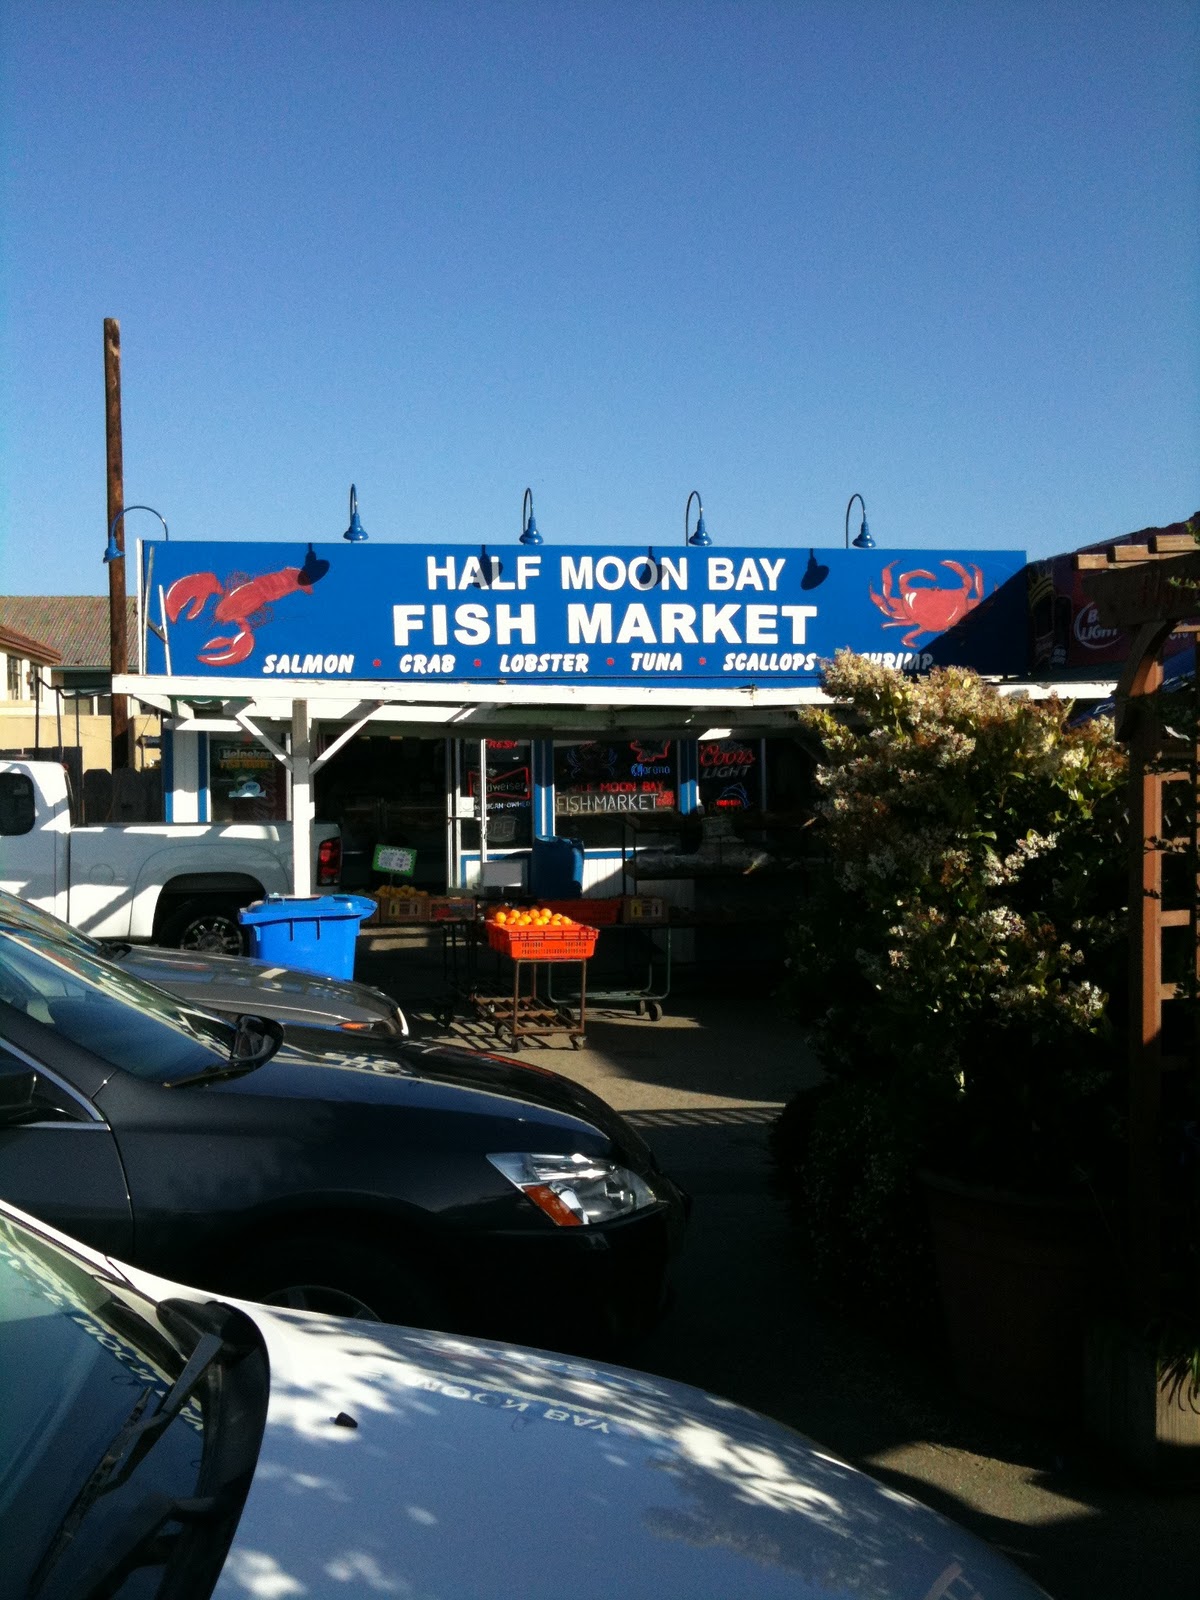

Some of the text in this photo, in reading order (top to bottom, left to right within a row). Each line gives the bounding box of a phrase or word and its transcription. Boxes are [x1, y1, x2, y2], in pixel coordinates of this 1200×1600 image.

[426, 556, 786, 591] HALF MOON BAY
[393, 603, 818, 646] FISH MARKET
[262, 654, 355, 675] SALMON
[399, 653, 456, 675] CRAB
[499, 653, 590, 674] LOBSTER
[630, 652, 683, 672] TUNA
[722, 652, 818, 672] SCALLOPS
[699, 743, 757, 767] Coors
[630, 762, 671, 778] Corona
[702, 765, 751, 779] LIGHT
[599, 781, 637, 793] MOON
